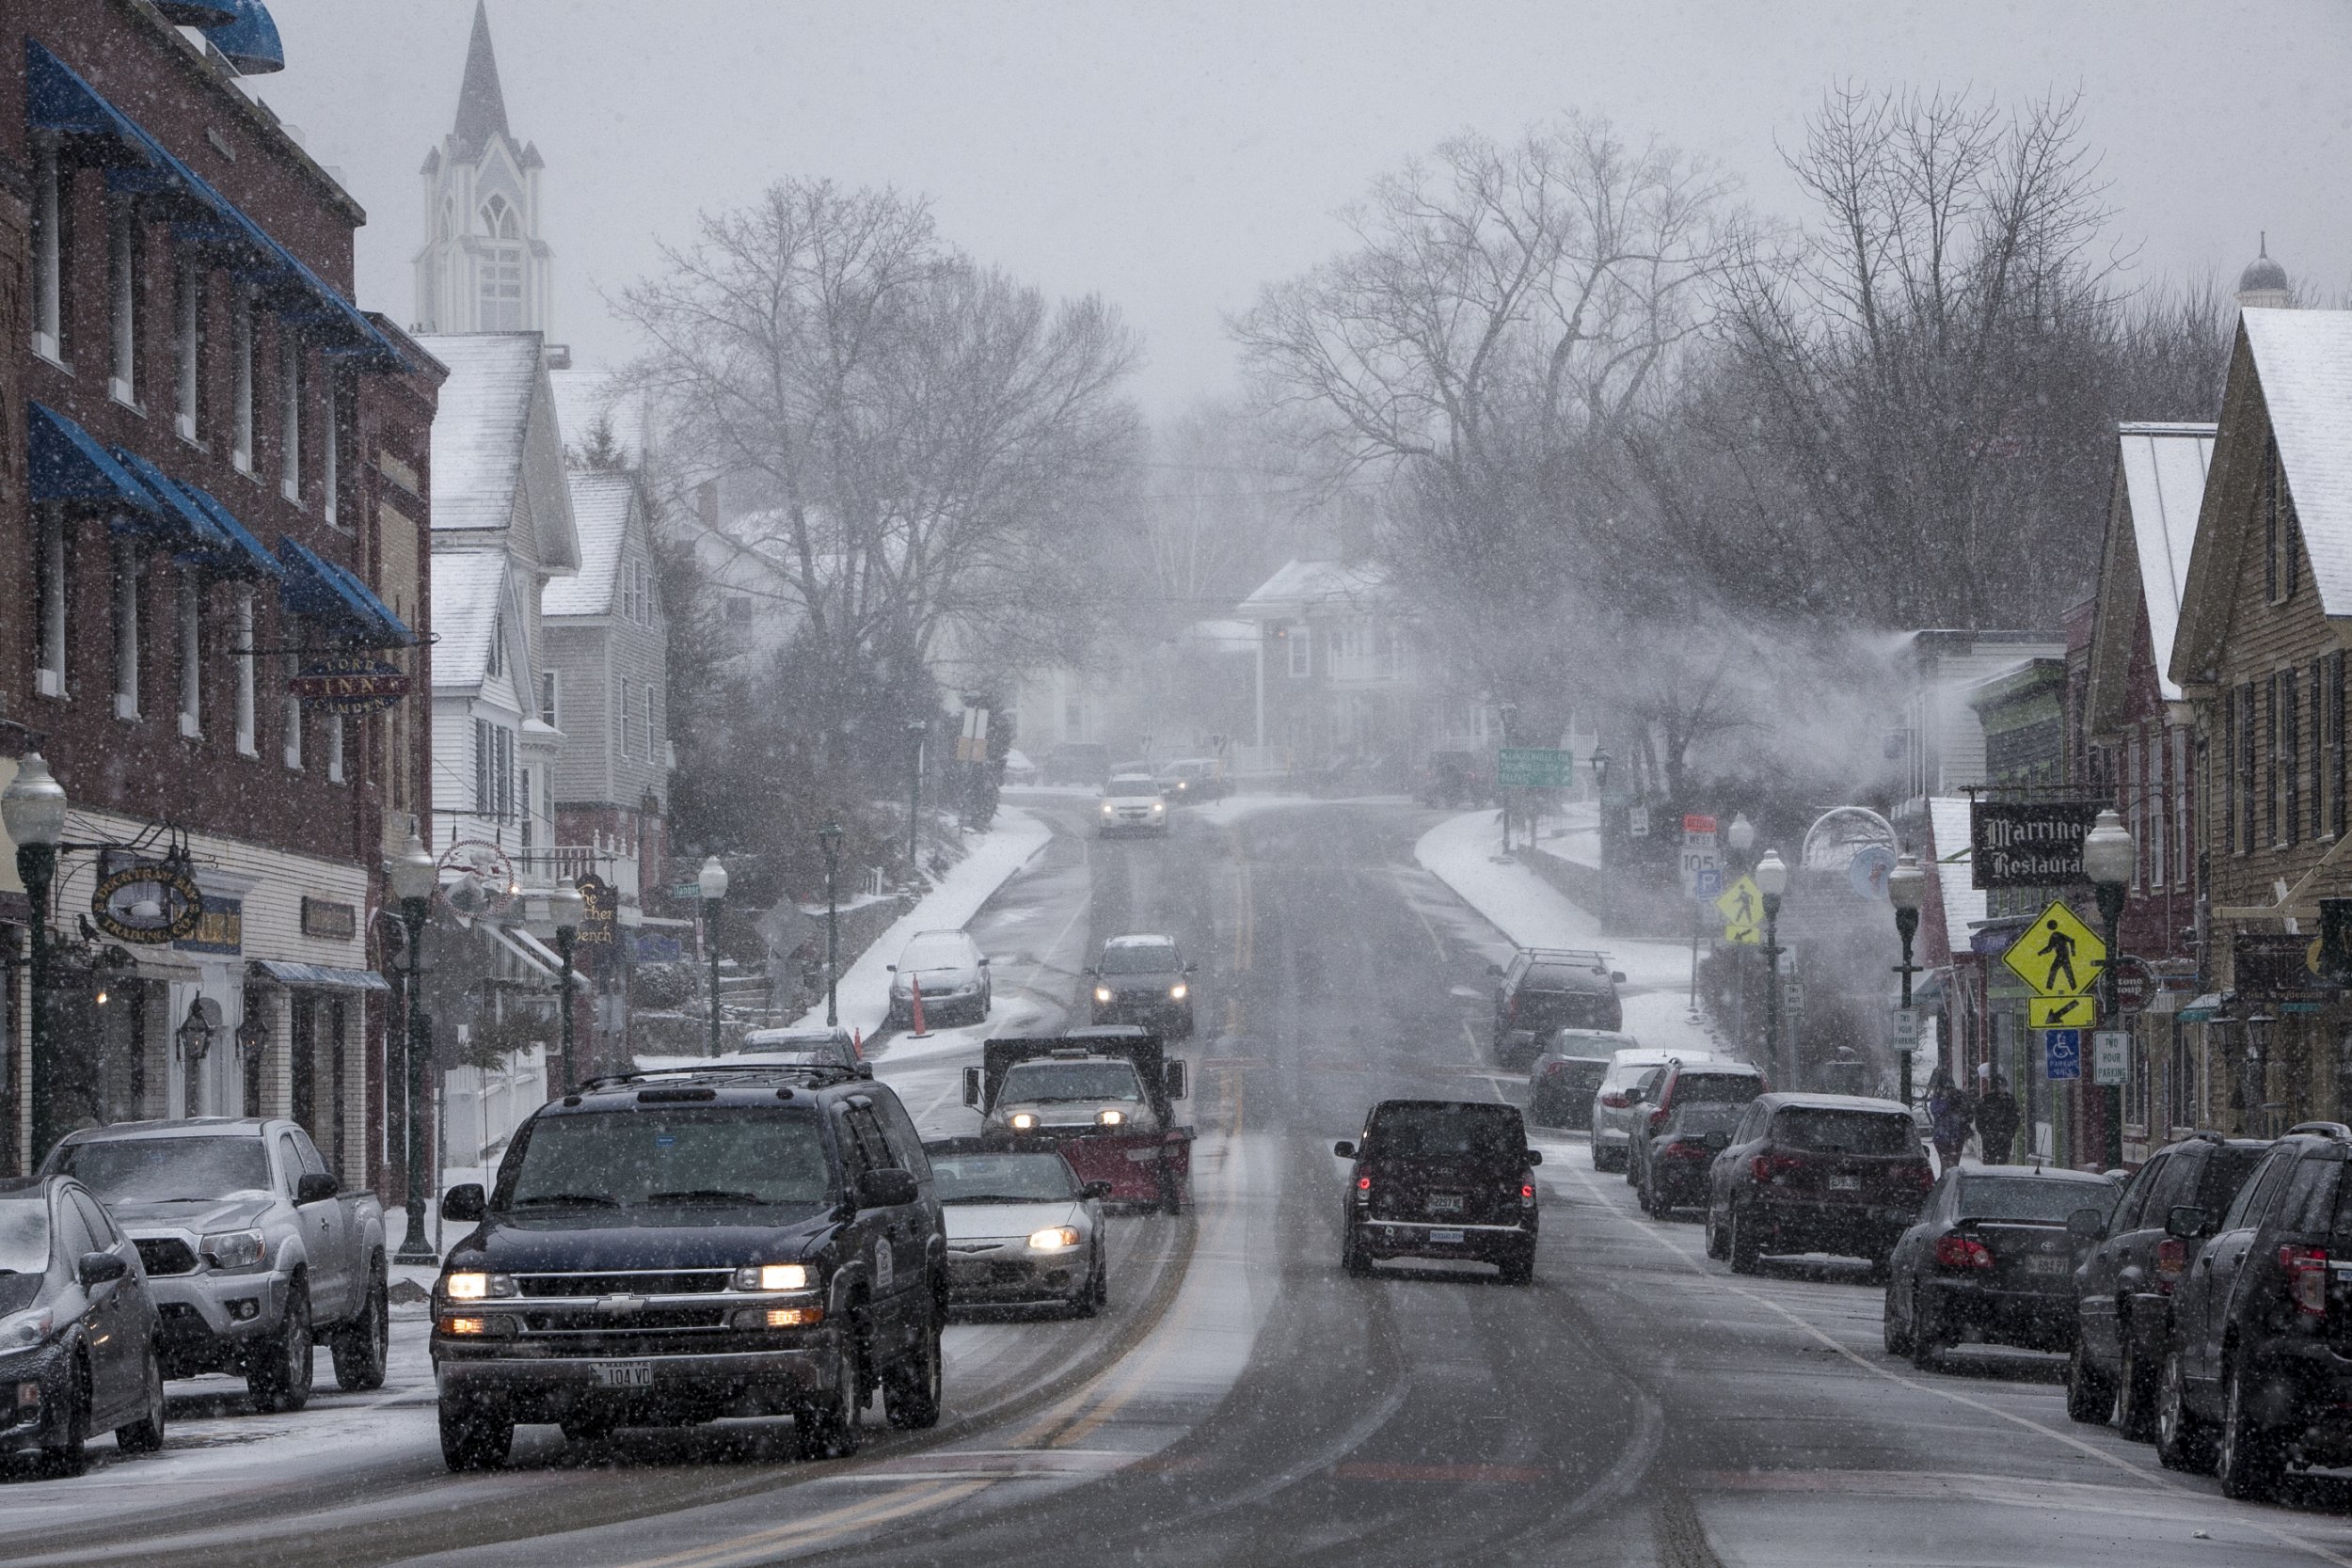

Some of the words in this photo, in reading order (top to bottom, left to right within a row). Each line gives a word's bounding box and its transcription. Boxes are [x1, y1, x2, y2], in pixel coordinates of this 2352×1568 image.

[324, 678, 375, 695] INN
[314, 698, 385, 715] CAMDEN
[1687, 817, 1713, 829] DETOUR
[1690, 835, 1711, 845] WEST
[1683, 854, 1714, 871] 105
[1992, 851, 2089, 878] Restaura
[582, 905, 613, 921] ther
[103, 917, 167, 940] TRADING
[2117, 977, 2143, 986] tone
[1899, 1014, 1911, 1022] TWO
[1898, 1025, 1913, 1034] HOUR
[1894, 1037, 1916, 1045] PARKING
[2105, 1037, 2119, 1048] TWO
[2103, 1053, 2122, 1063] HOUR
[2098, 1068, 2126, 1079] PARKING
[609, 1368, 631, 1386] 104
[634, 1368, 650, 1385] VD
